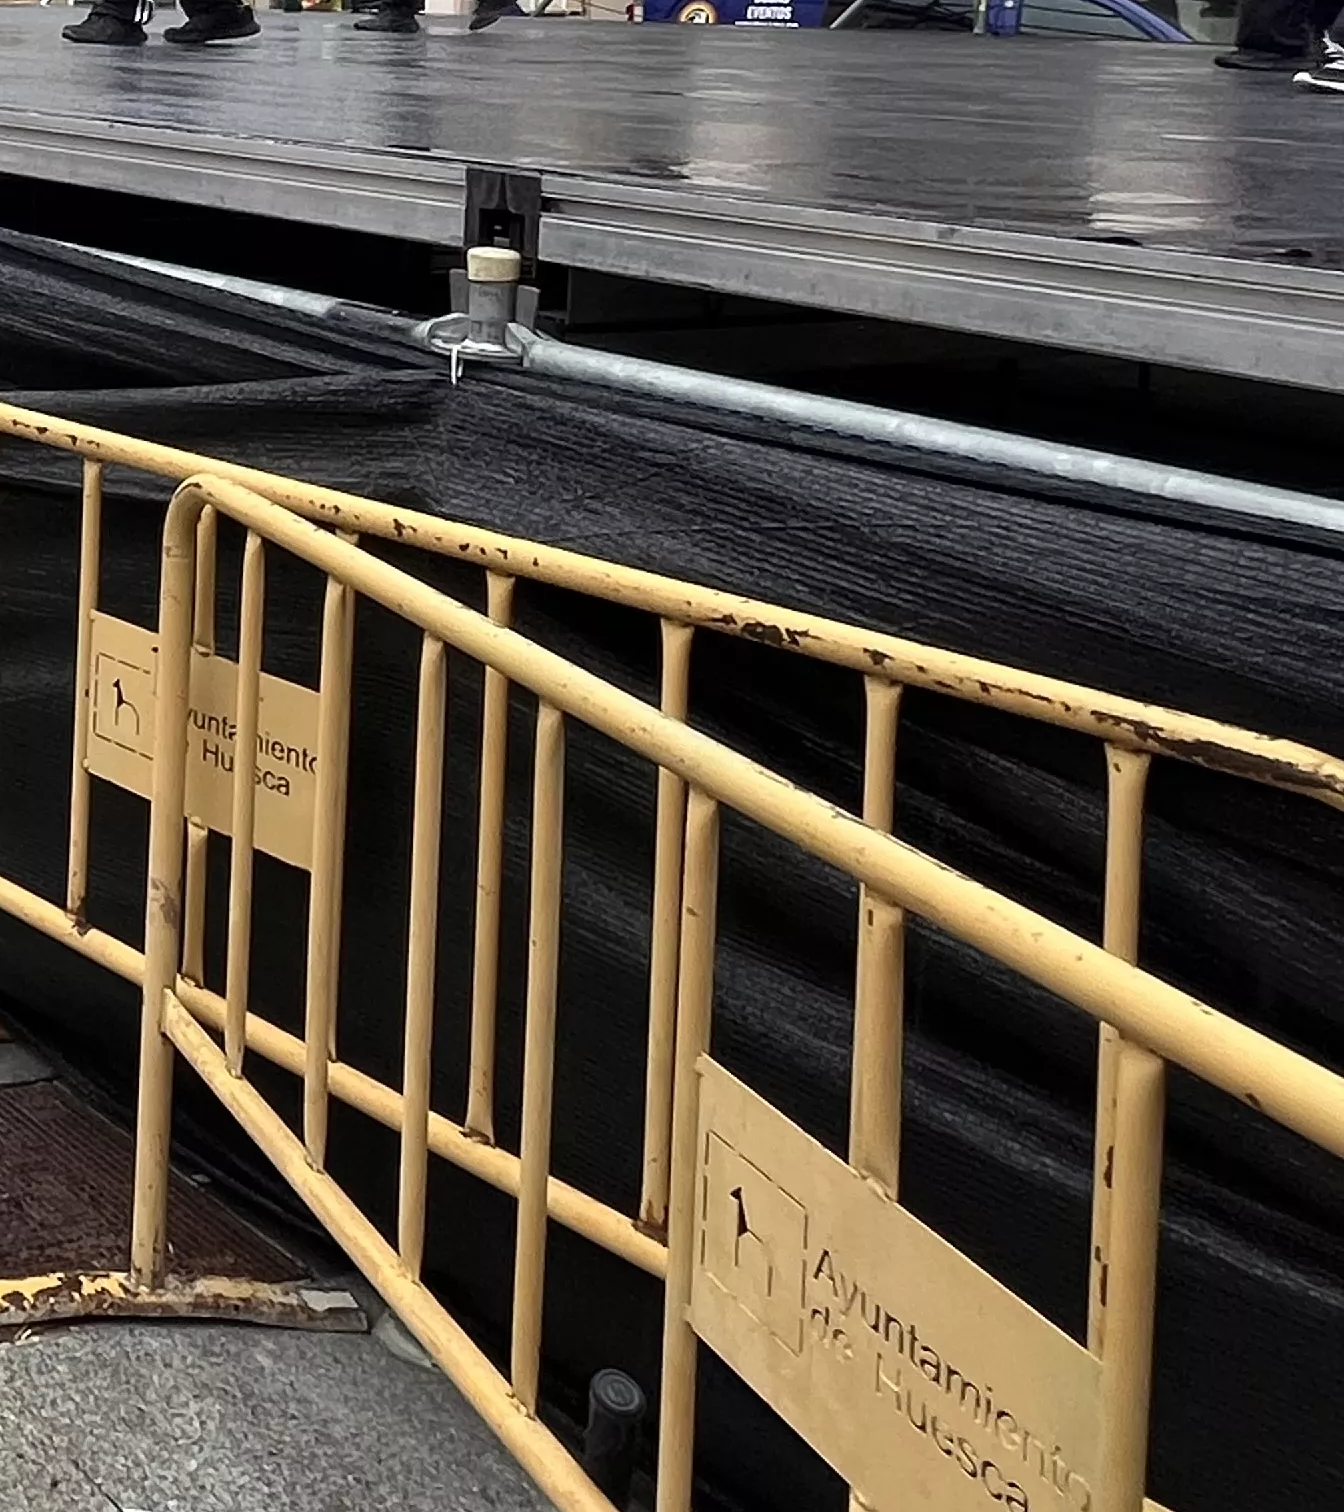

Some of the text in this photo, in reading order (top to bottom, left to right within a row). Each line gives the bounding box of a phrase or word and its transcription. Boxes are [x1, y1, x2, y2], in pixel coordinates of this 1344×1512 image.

[202, 739, 289, 797] Husca
[811, 1307, 1028, 1512] de Huesca
[813, 1248, 1092, 1512] Ayuntamiento
